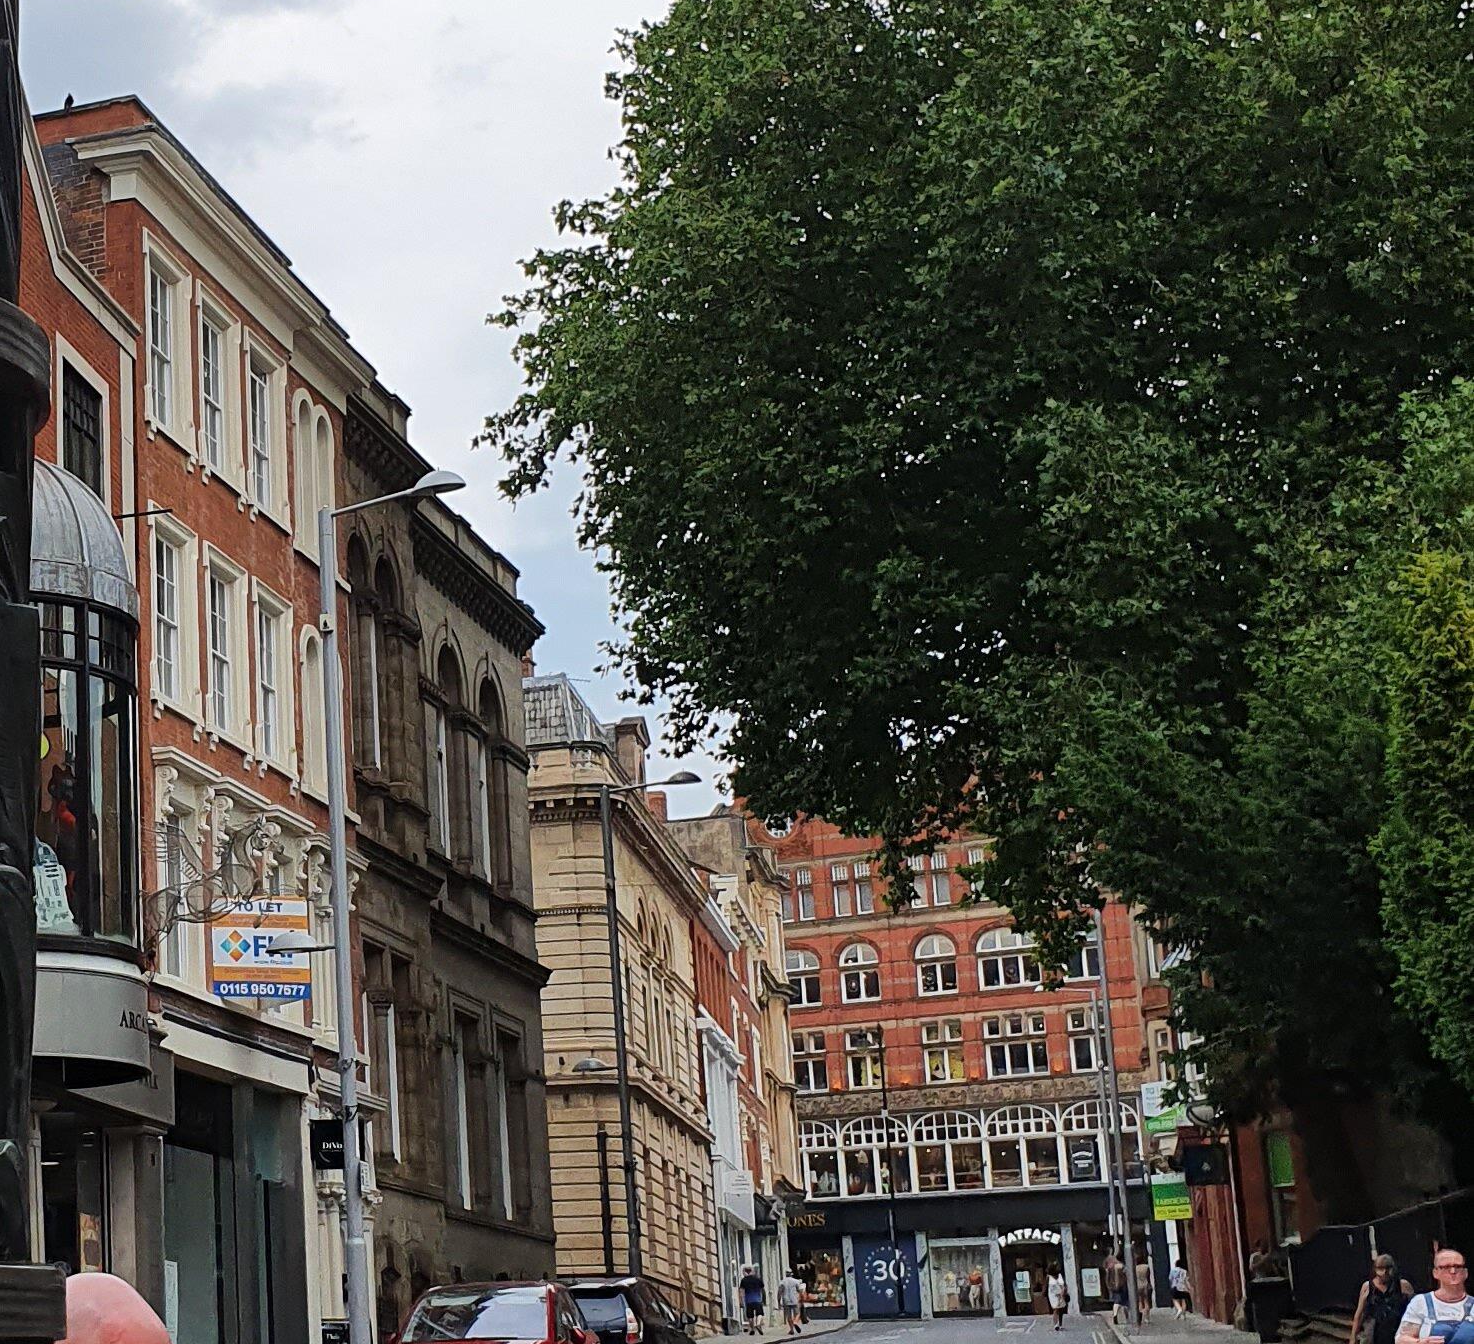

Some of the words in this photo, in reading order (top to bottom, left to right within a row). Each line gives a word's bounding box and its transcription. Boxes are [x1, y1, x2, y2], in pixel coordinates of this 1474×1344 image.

[237, 901, 253, 912] TO
[259, 902, 283, 913] LET
[219, 983, 248, 995] 0115
[250, 984, 275, 995] 950
[998, 1228, 1061, 1248] FATFACE
[872, 1258, 905, 1281] 30
